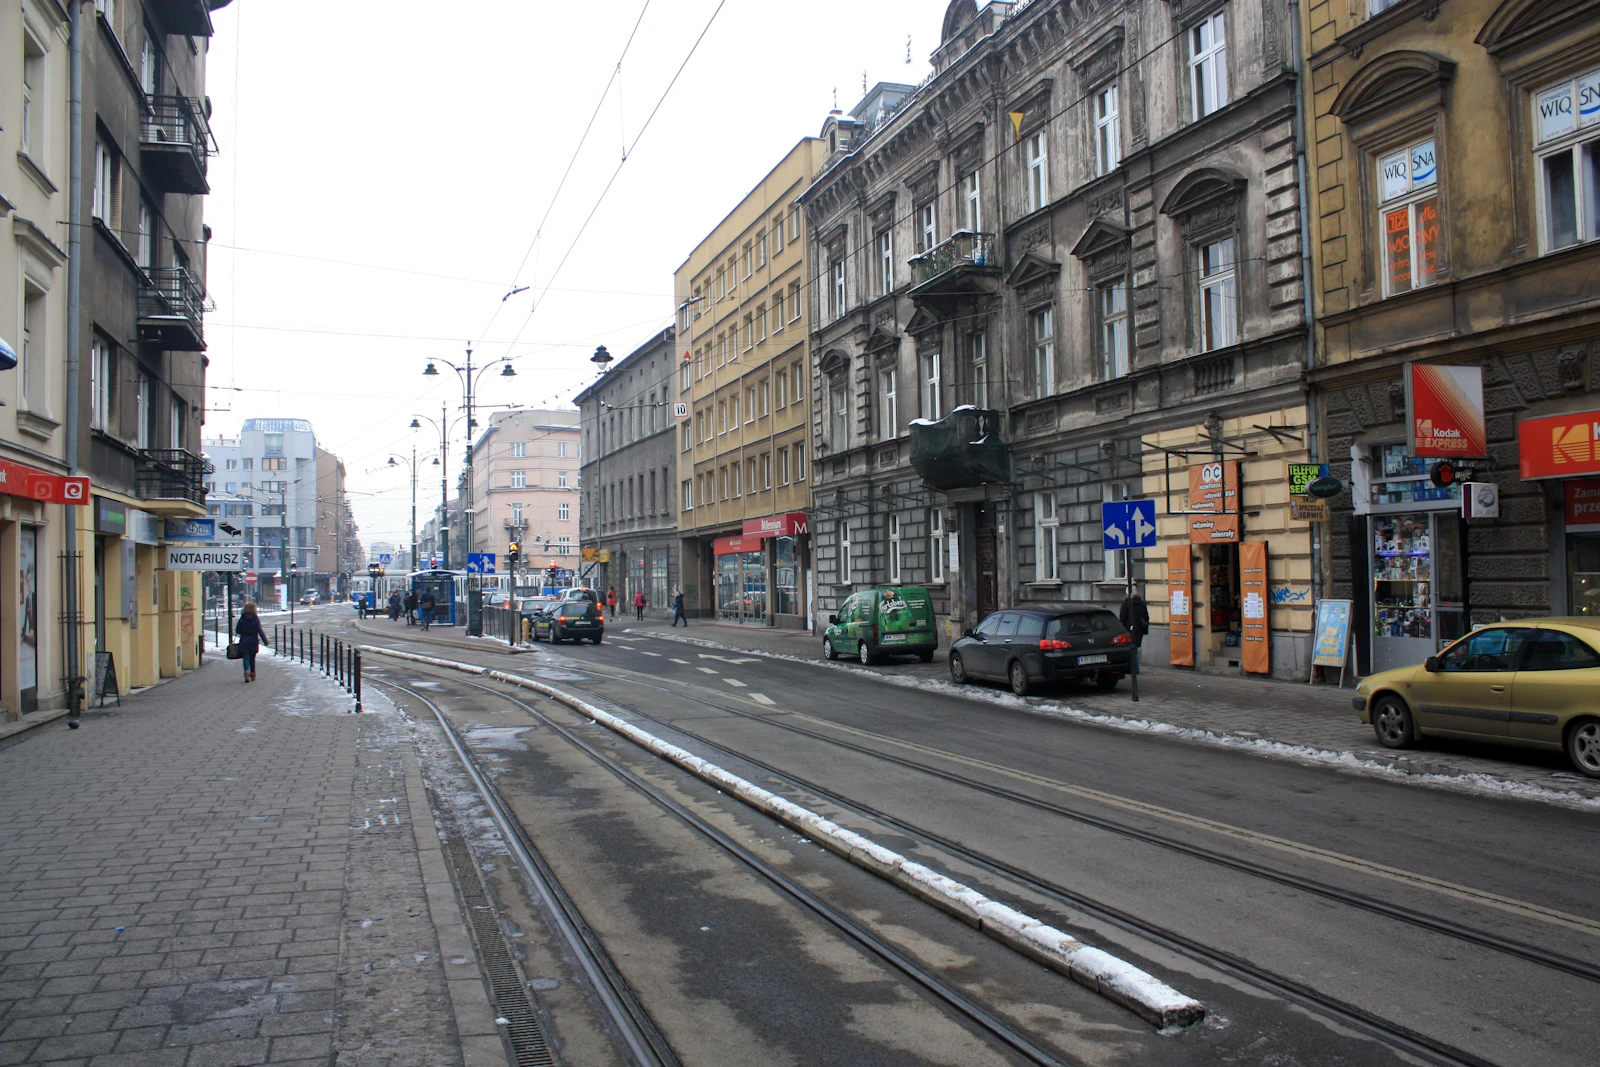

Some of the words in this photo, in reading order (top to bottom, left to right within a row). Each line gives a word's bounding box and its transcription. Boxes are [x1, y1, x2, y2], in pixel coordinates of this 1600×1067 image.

[1419, 206, 1437, 222] dla
[676, 405, 686, 415] 10
[1433, 428, 1461, 438] Kodak
[1424, 437, 1468, 449] EXPRESS
[1289, 464, 1319, 475] TELEFON
[170, 553, 239, 564] NOTARIUSZ
